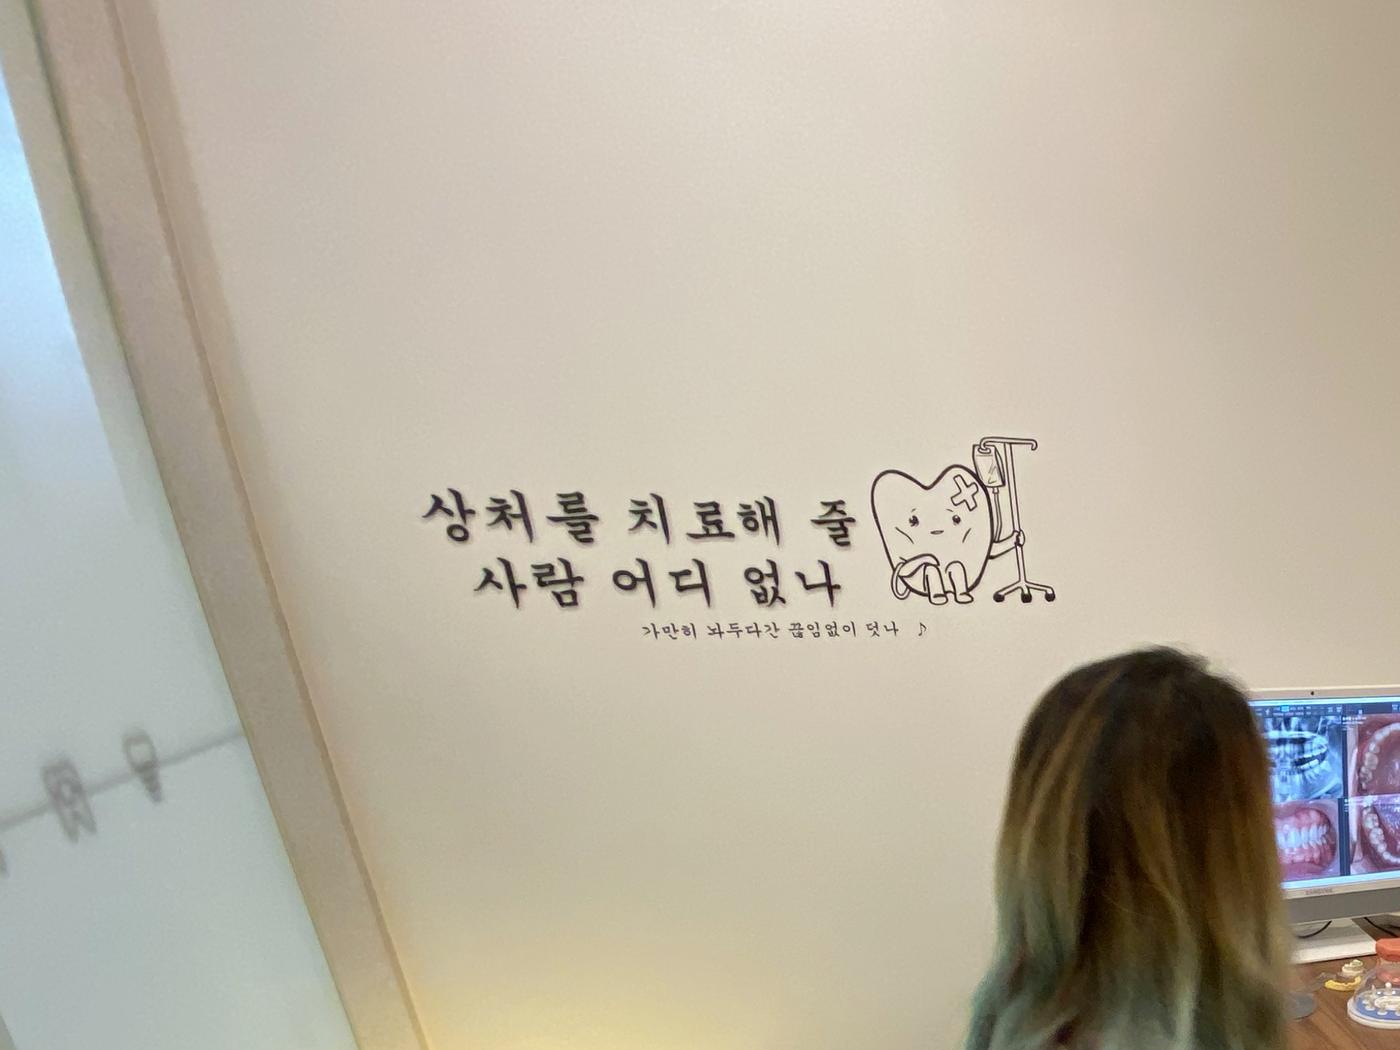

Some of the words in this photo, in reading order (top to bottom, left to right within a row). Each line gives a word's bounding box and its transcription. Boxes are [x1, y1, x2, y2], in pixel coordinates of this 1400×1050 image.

[422, 488, 600, 546] 상처를
[628, 493, 780, 547] 치료해
[810, 499, 856, 550] 줄
[474, 557, 585, 609] 사람
[612, 558, 711, 608] 어디
[744, 559, 842, 608] 없나
[642, 622, 696, 640] 가만히
[707, 621, 780, 640] 놔두다간
[788, 621, 856, 639] 끊임없이
[866, 621, 899, 638] 덧나
